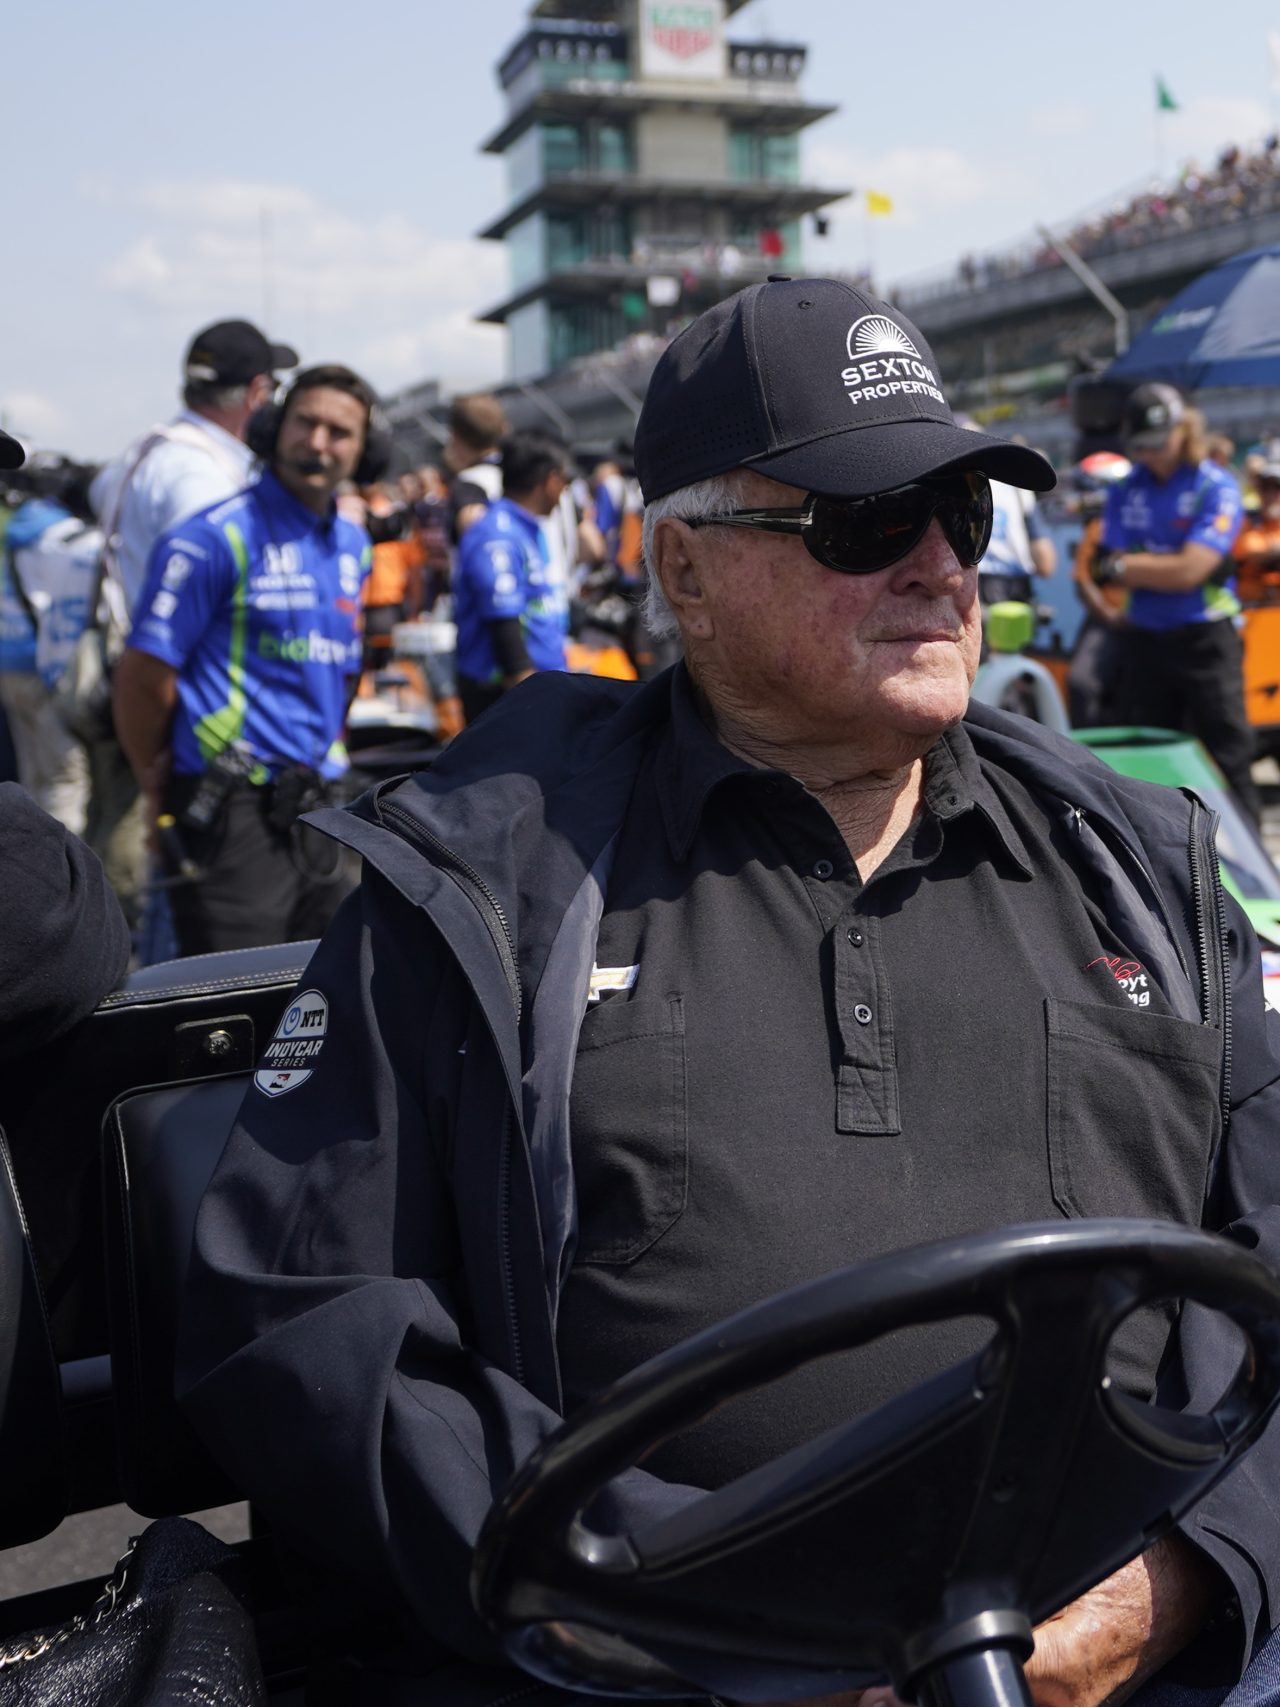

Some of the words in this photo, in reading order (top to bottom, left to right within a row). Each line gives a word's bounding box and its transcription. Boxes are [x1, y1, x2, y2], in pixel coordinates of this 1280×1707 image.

[841, 358, 937, 386] SEXTON
[848, 381, 945, 404] PROPERTIES
[1118, 974, 1148, 992] oyt
[300, 1009, 324, 1028] NTT
[264, 1040, 324, 1058] INDYCAR
[271, 1057, 306, 1067] SERIES
